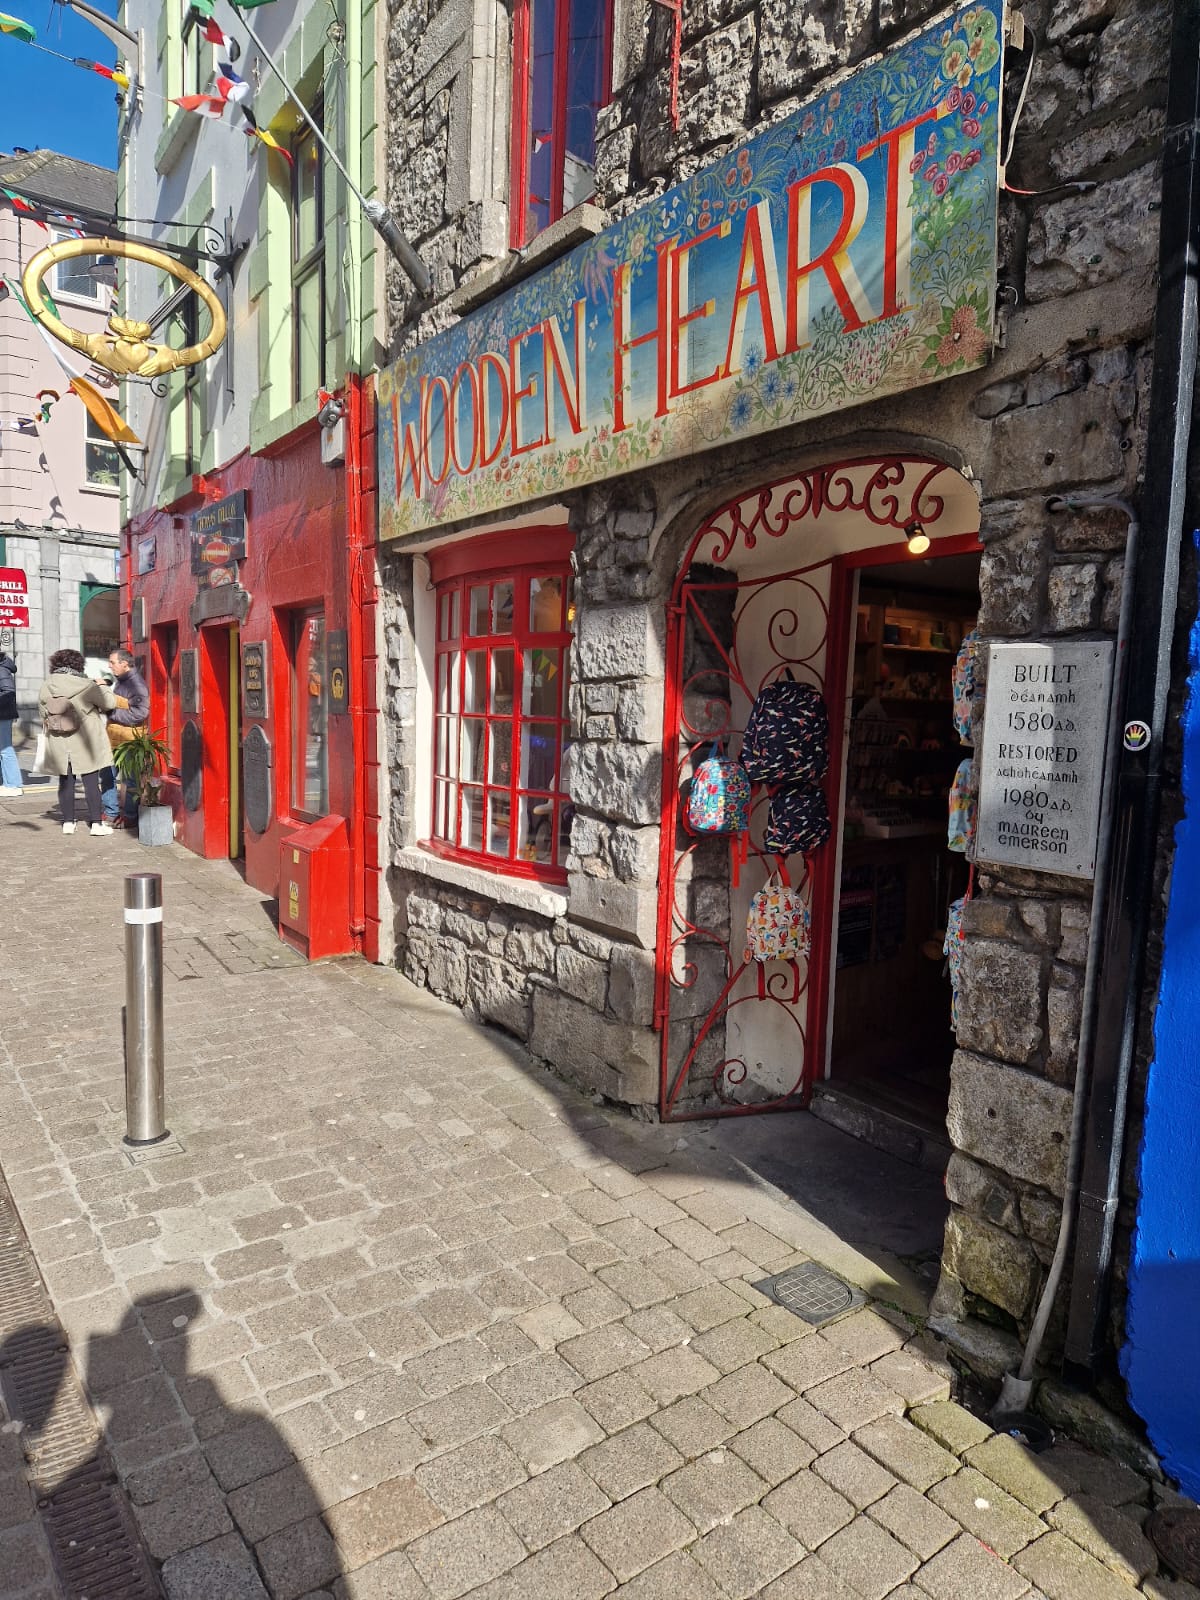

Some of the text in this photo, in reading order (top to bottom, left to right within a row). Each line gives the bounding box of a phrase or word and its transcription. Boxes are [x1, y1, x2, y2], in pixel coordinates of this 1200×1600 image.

[391, 101, 952, 506] WOODEN HEART
[1014, 664, 1077, 684] BUILT
[998, 743, 1078, 763] RESTORED
[1025, 809, 1044, 825] by
